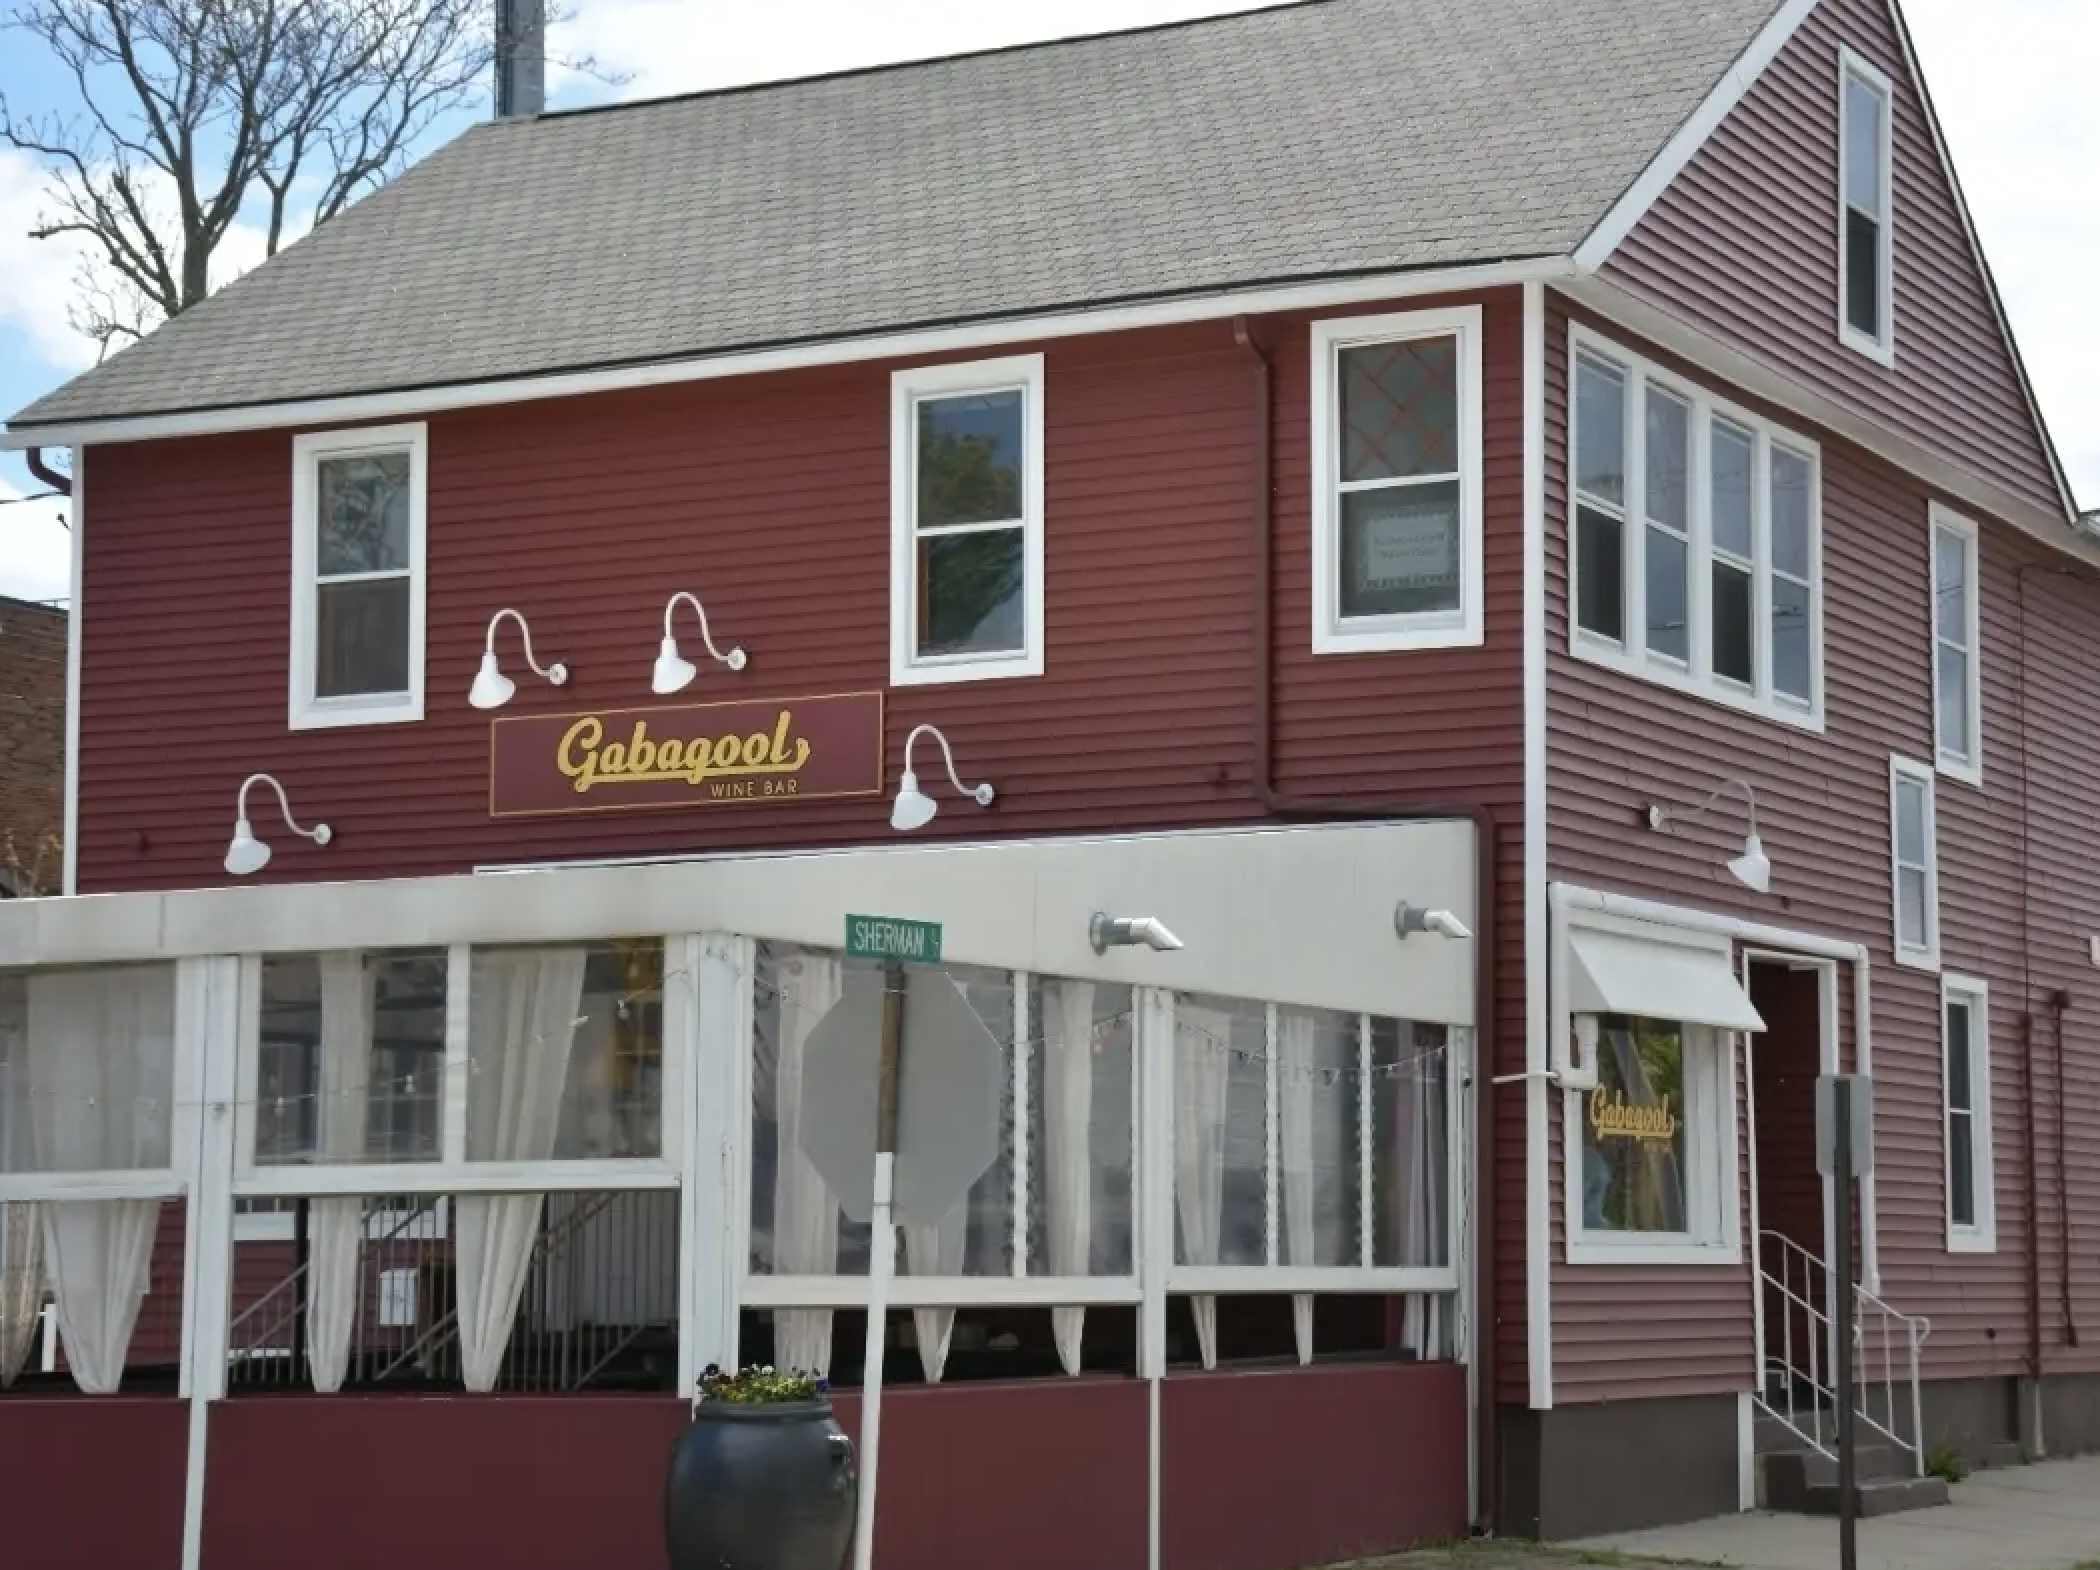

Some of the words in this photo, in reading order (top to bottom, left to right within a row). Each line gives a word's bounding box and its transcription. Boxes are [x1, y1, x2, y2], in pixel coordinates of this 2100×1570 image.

[557, 710, 811, 793] Gabagool
[710, 781, 755, 798] WINE
[762, 779, 798, 795] BAR
[853, 921, 925, 957] SHERMAN
[1590, 1081, 1675, 1141] Gabagool
